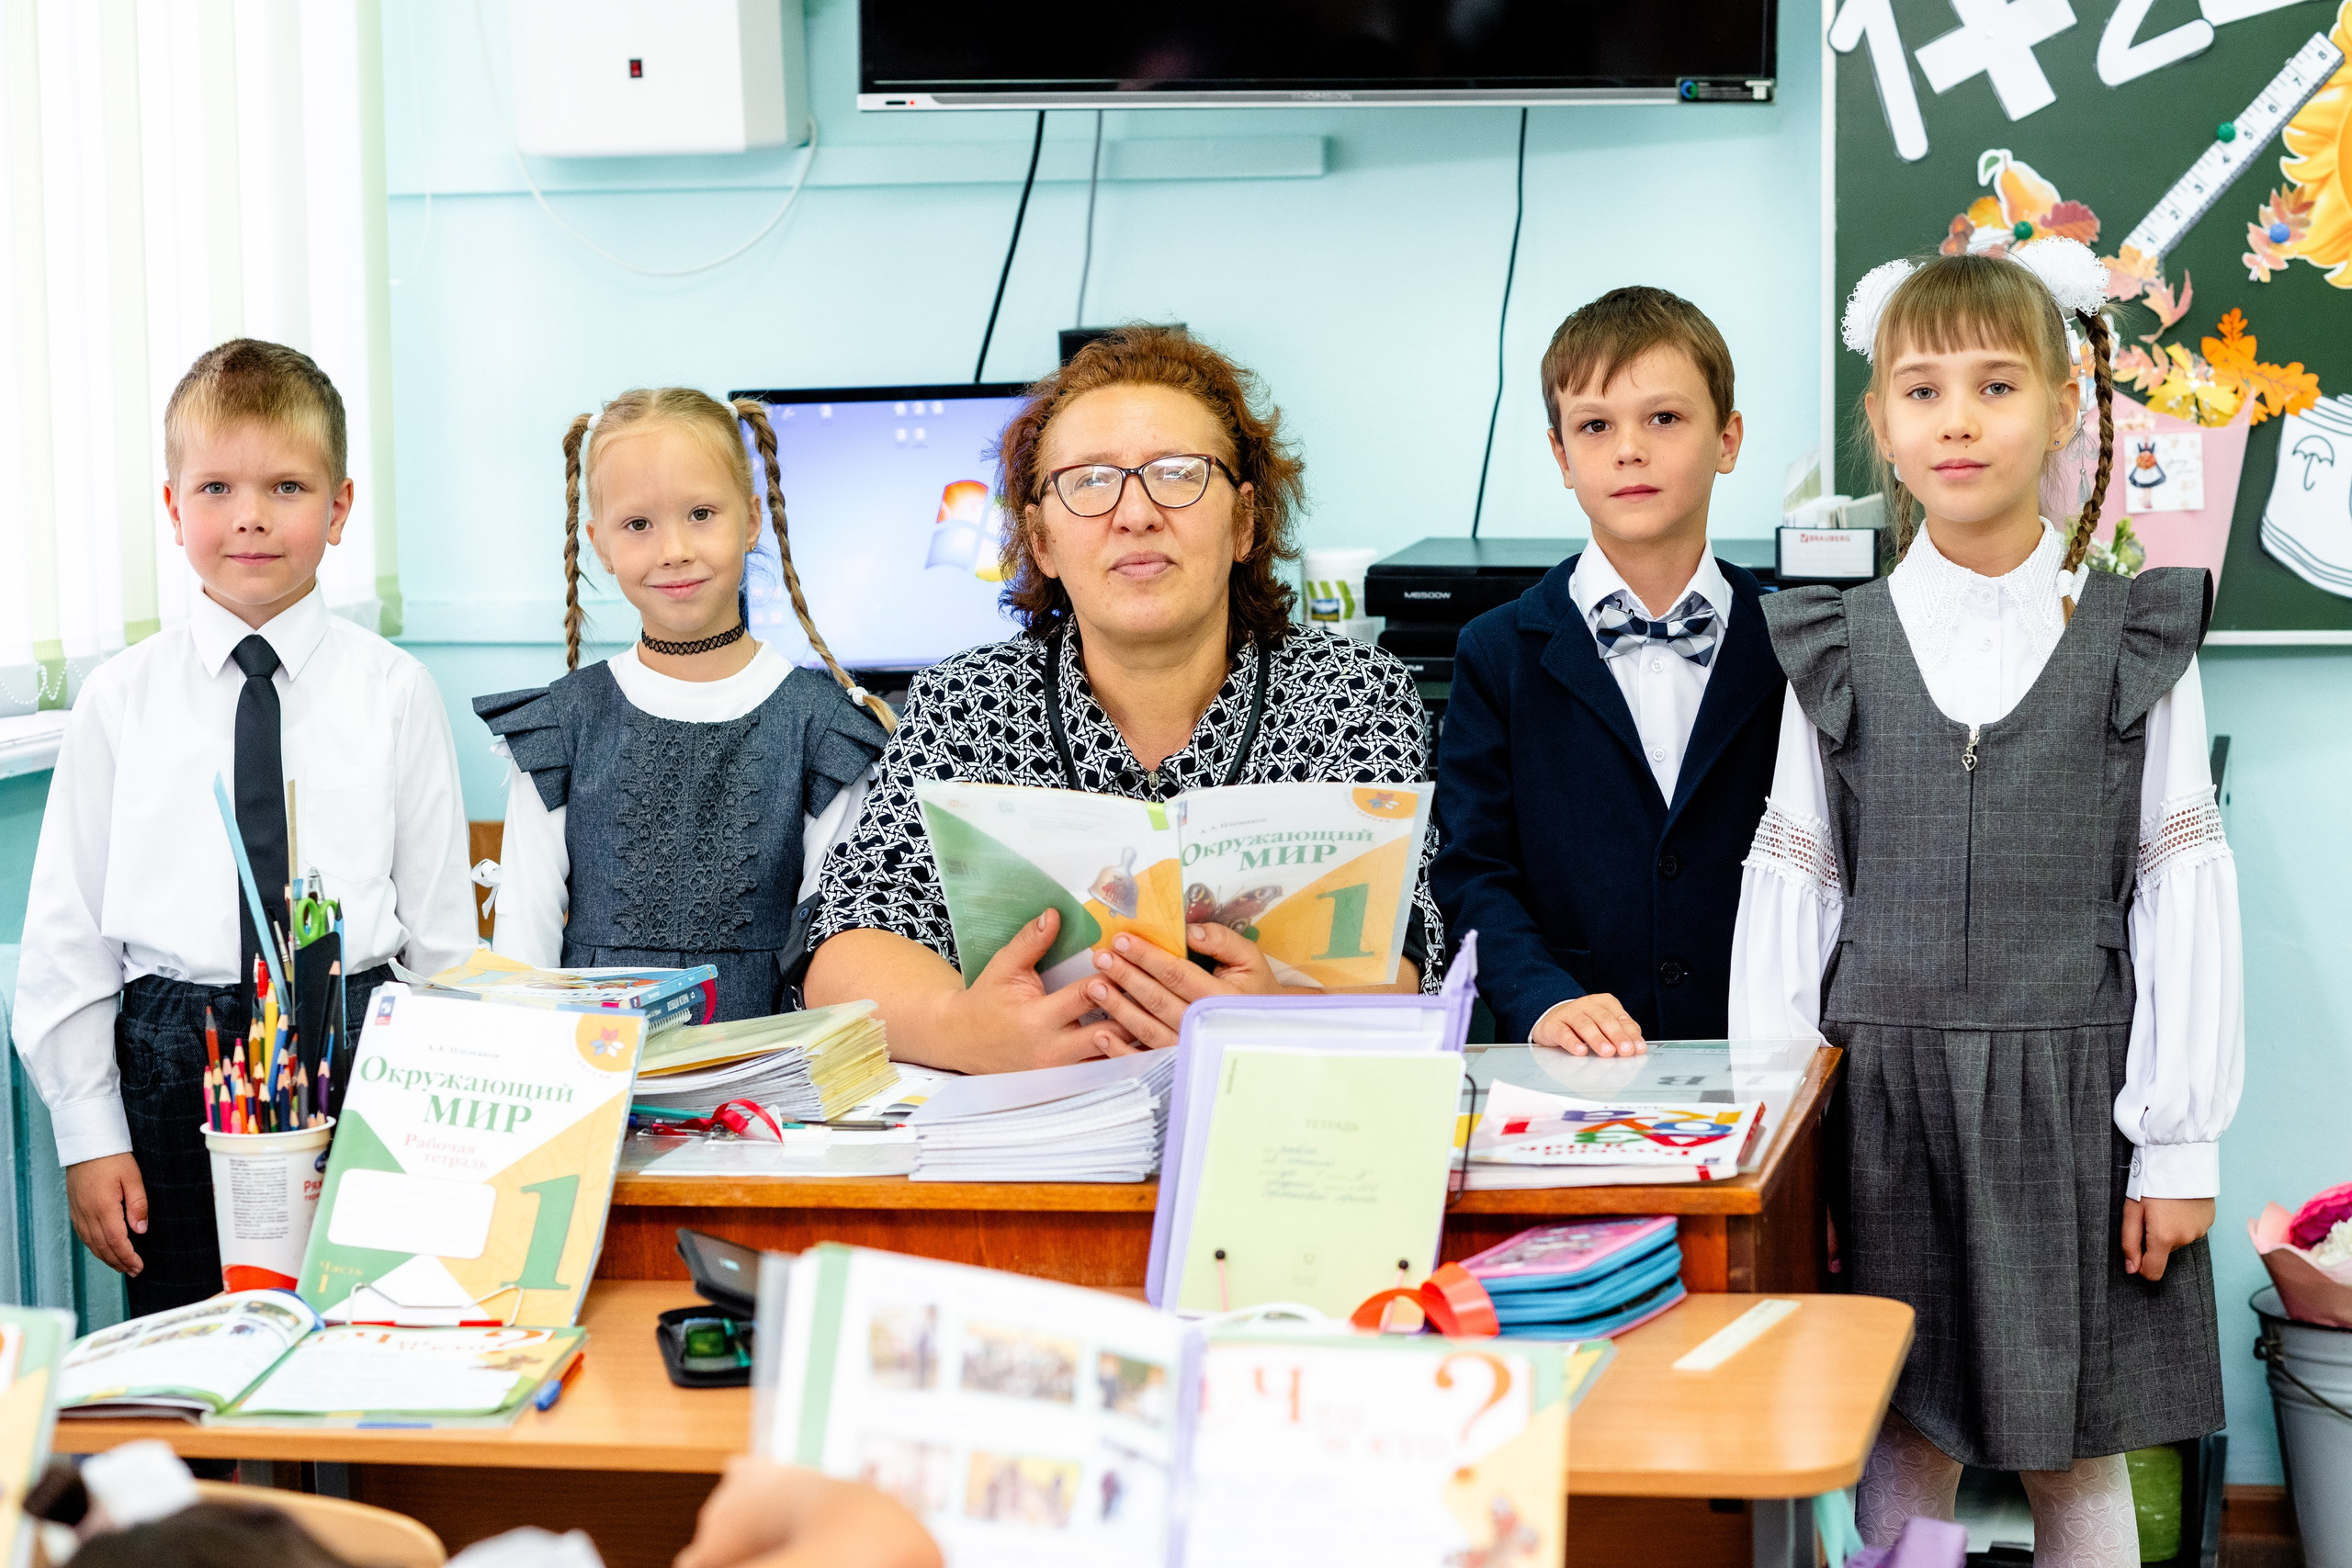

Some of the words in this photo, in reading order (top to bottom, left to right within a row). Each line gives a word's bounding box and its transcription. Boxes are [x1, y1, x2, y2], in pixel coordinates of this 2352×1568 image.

[2292, 76, 2302, 87] 7
[2317, 51, 2328, 61] 8
[1809, 534, 1850, 542] BRAUBERG
[1182, 829, 1374, 866] Окружающий
[1238, 844, 1338, 872] МИР
[1311, 883, 1374, 961] 1
[360, 1055, 574, 1104] Окружающий
[422, 1094, 533, 1134] МИР
[404, 1133, 476, 1156] Рабочая
[423, 1153, 488, 1168] тетрадь
[501, 1175, 581, 1291] 1
